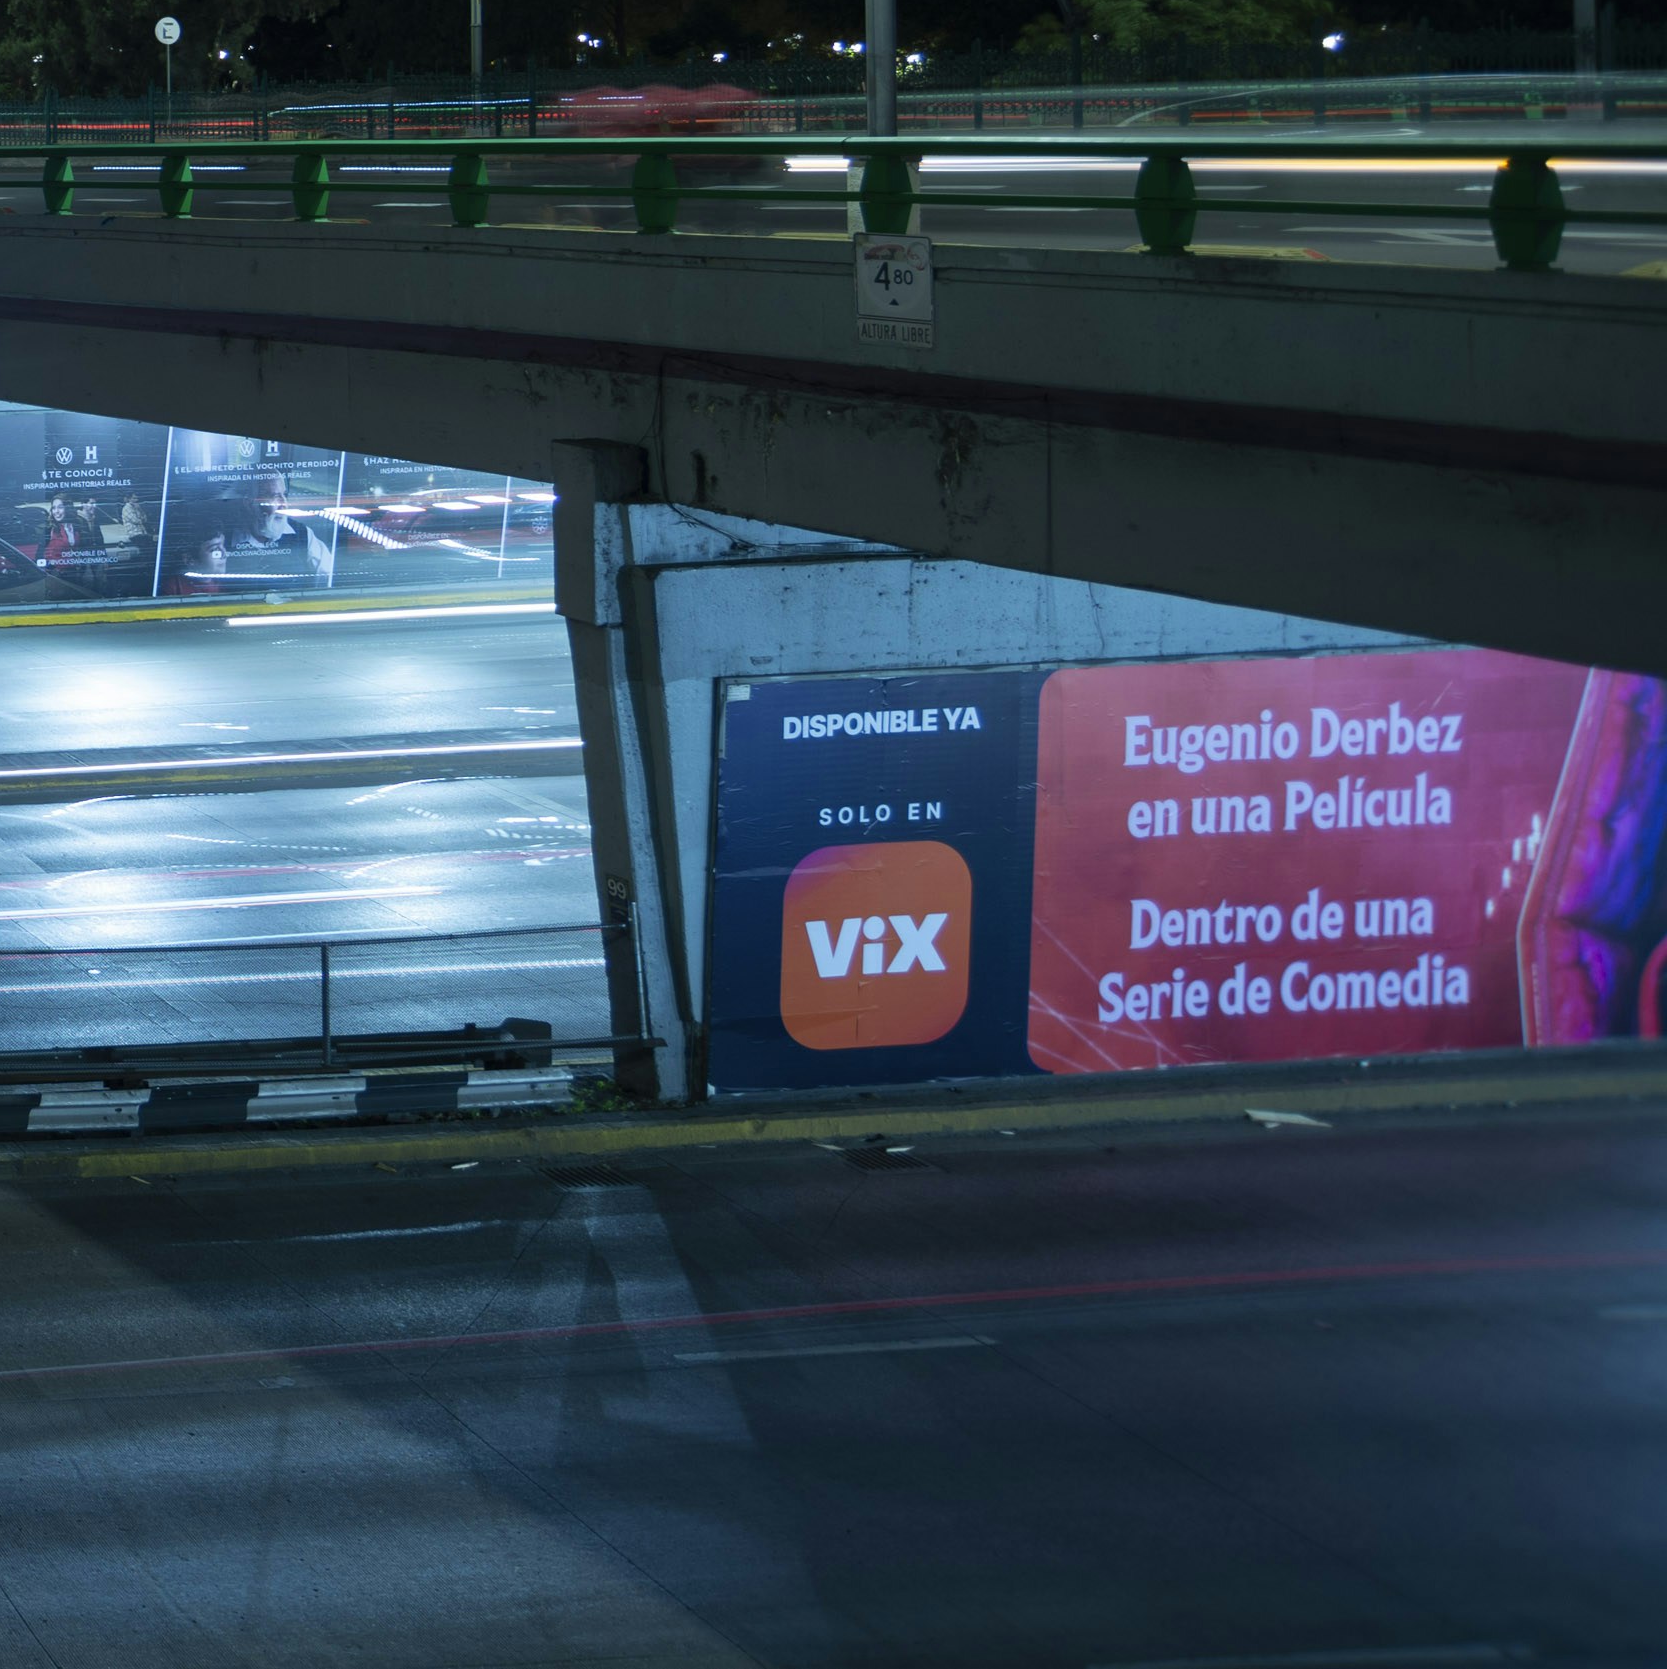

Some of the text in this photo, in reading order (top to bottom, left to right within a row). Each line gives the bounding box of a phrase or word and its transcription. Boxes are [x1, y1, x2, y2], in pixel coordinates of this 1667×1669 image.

[861, 323, 931, 344] ALTURA LIBRE
[65, 468, 107, 478] CONOCÍ
[207, 471, 312, 482] INSPIRADA EN HISTORIAS REALES
[236, 463, 254, 471] DEL
[256, 462, 294, 470] VOCHITO
[296, 460, 334, 468] PERDIDO
[23, 482, 58, 490] INSPIRADA
[71, 480, 105, 488] HISTORIAS
[783, 706, 981, 739] DISPONIBLE YA
[1123, 701, 1463, 774] Eugenio Derbez
[819, 801, 942, 826] SOLO EN
[1127, 772, 1452, 838] en una Película
[1129, 886, 1434, 949] Dentro de una
[805, 912, 948, 978] ViX
[1098, 967, 1209, 1023] Serie
[1218, 962, 1271, 1016] de
[1280, 952, 1470, 1013] Comedia
